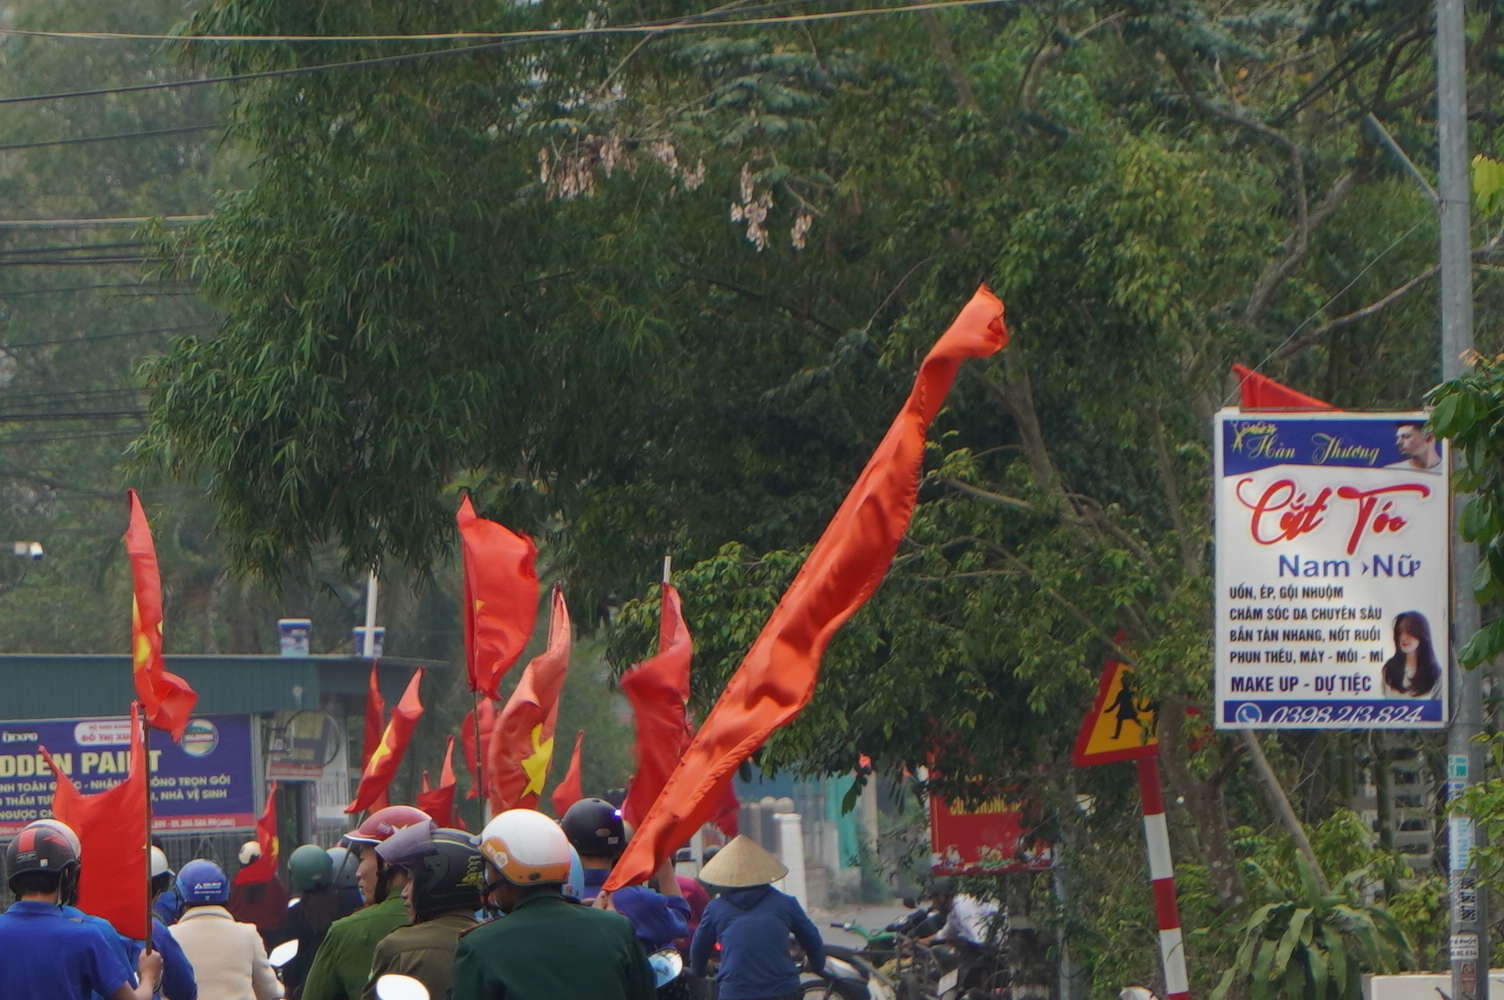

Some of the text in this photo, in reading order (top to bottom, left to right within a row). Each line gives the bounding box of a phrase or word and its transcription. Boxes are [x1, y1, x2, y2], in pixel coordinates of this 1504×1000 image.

[1236, 478, 1430, 555] Cắt Tóc
[1278, 554, 1421, 577] Nam Nữ
[1260, 583, 1276, 600] ÉP,
[1279, 583, 1298, 602] GỘI
[1302, 583, 1344, 602] NHUỘM
[1229, 604, 1382, 621] CHĂM SÓC DA CHUYÊN SÂU
[1282, 628, 1325, 643] NHANG,
[1229, 650, 1261, 664] PHUN
[1264, 648, 1296, 665] THÊU,
[1336, 647, 1358, 663] MÔI
[1369, 647, 1384, 663] MÍ
[1231, 676, 1274, 692] MAKE
[1280, 676, 1299, 692] UP
[1315, 674, 1336, 695] DỰ
[1339, 672, 1371, 695] TIỆC
[81, 750, 162, 774] PAIT
[18, 780, 47, 791] TOÀN
[209, 773, 231, 785] GÓI
[5, 793, 36, 806] THẤM
[161, 788, 184, 800] NHÀ
[187, 788, 200, 801] VỆ
[202, 788, 227, 799] SINH
